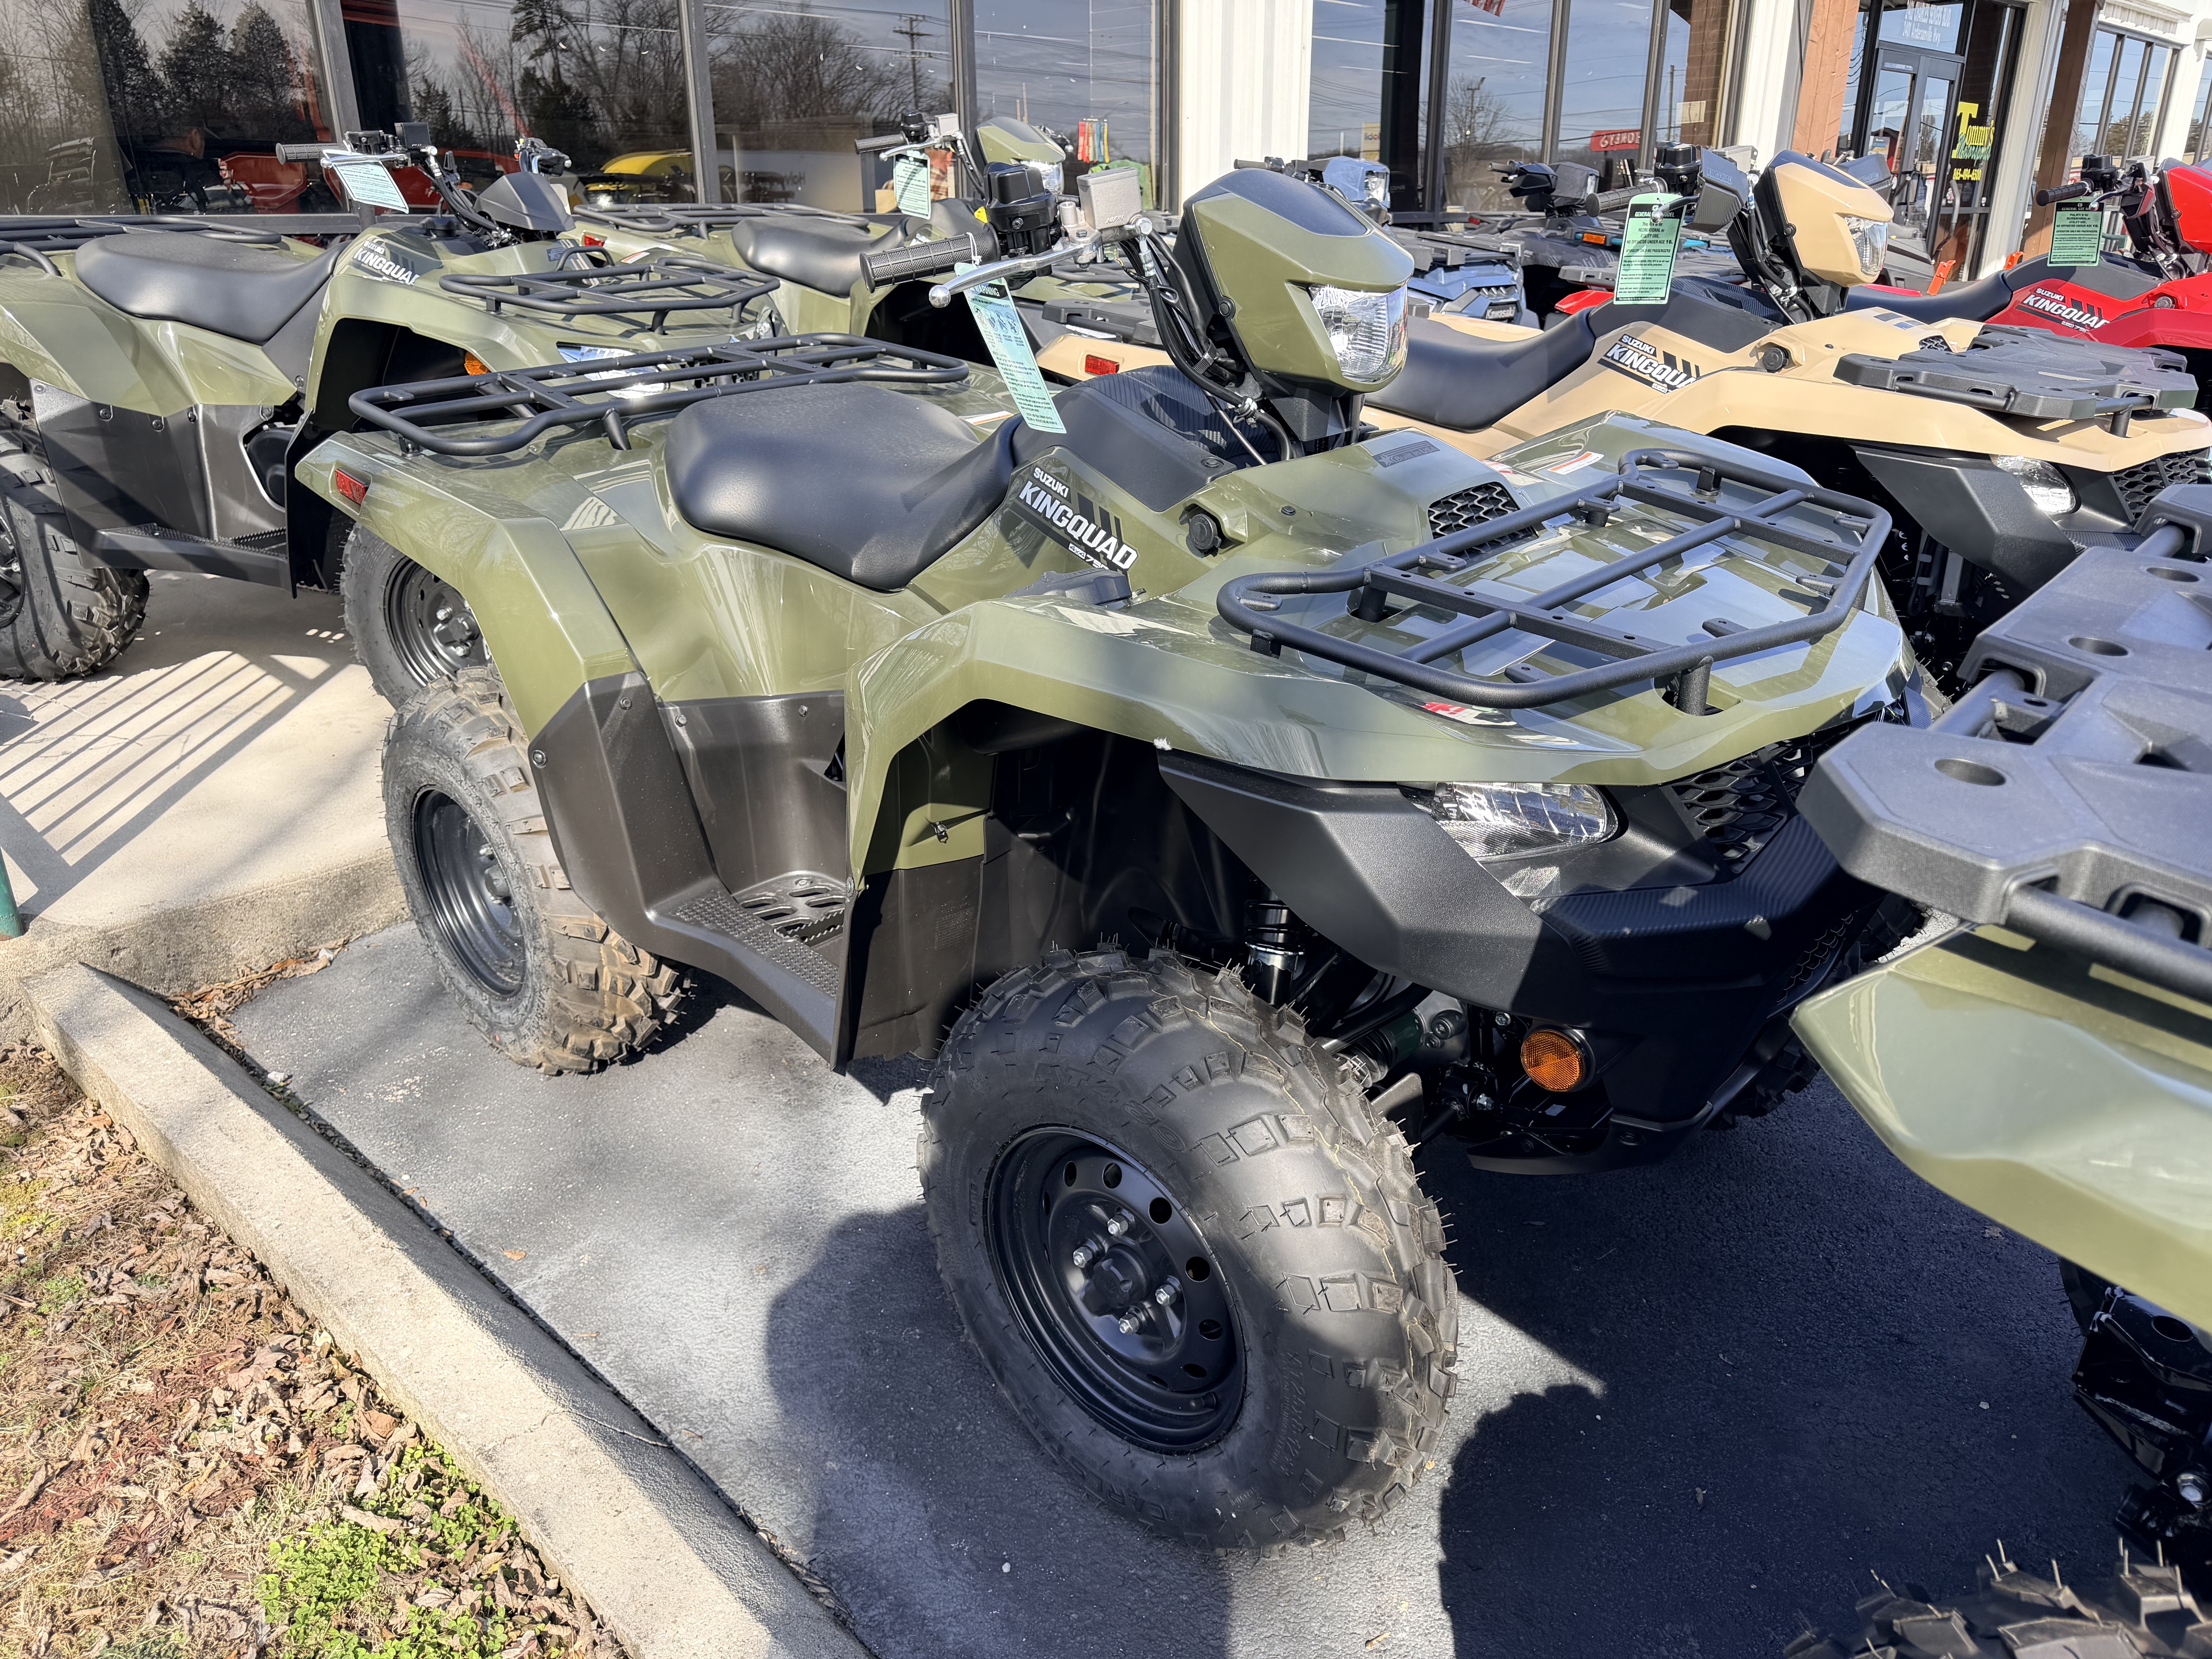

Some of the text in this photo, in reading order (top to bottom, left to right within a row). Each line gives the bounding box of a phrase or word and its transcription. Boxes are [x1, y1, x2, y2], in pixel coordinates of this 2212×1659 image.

[1951, 101, 1995, 159] Tommy's
[1707, 167, 1733, 185] KINGQUAD
[364, 240, 385, 254] SUZUKI
[975, 285, 1000, 297] WARNING
[2036, 288, 2064, 301] SUZUKI
[1486, 306, 1516, 319] Kawasaki
[1621, 335, 1655, 354] SUZUKI
[1395, 452, 1412, 462] Built
[1034, 467, 1069, 498] SUZUKI
[1019, 481, 1138, 569] KINGQUAD
